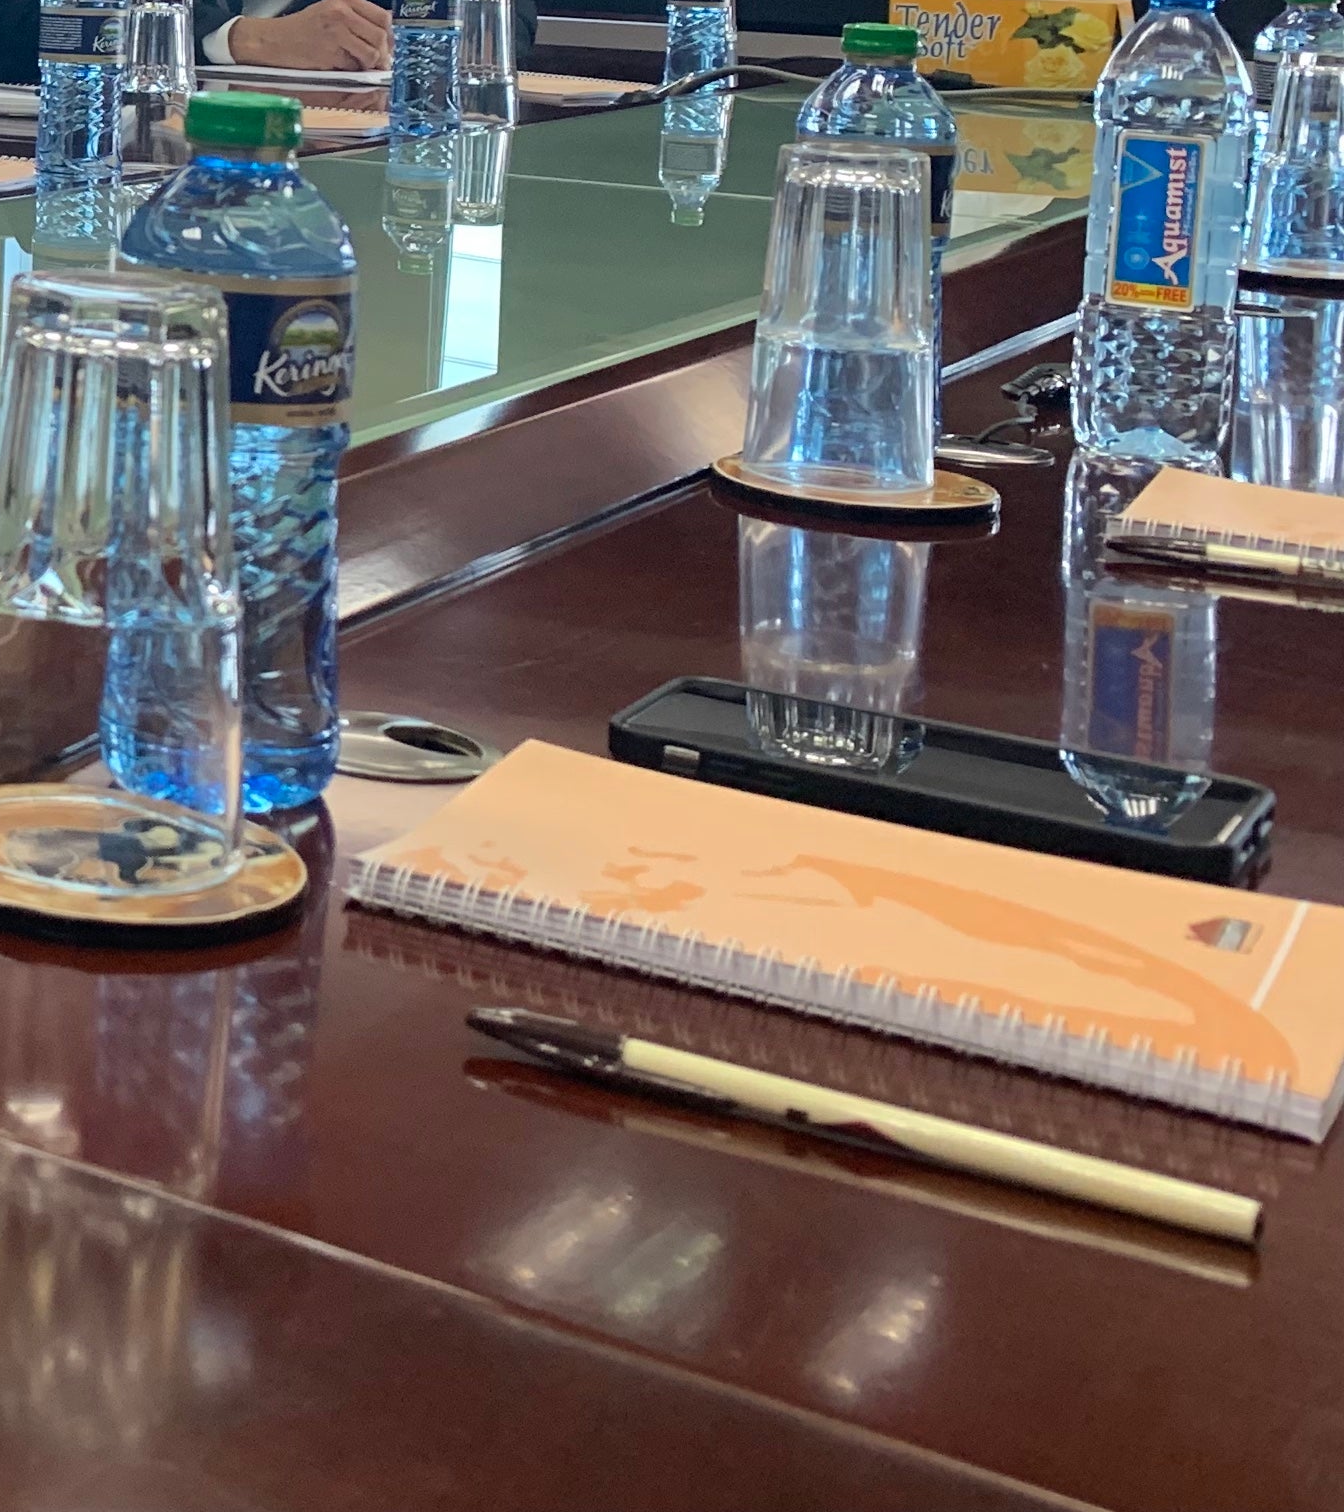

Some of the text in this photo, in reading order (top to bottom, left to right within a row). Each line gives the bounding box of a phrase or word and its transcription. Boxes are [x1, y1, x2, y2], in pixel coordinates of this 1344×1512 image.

[895, 1, 1002, 40] Tender
[1151, 147, 1188, 285] Aquamist
[1155, 286, 1187, 303] FREE
